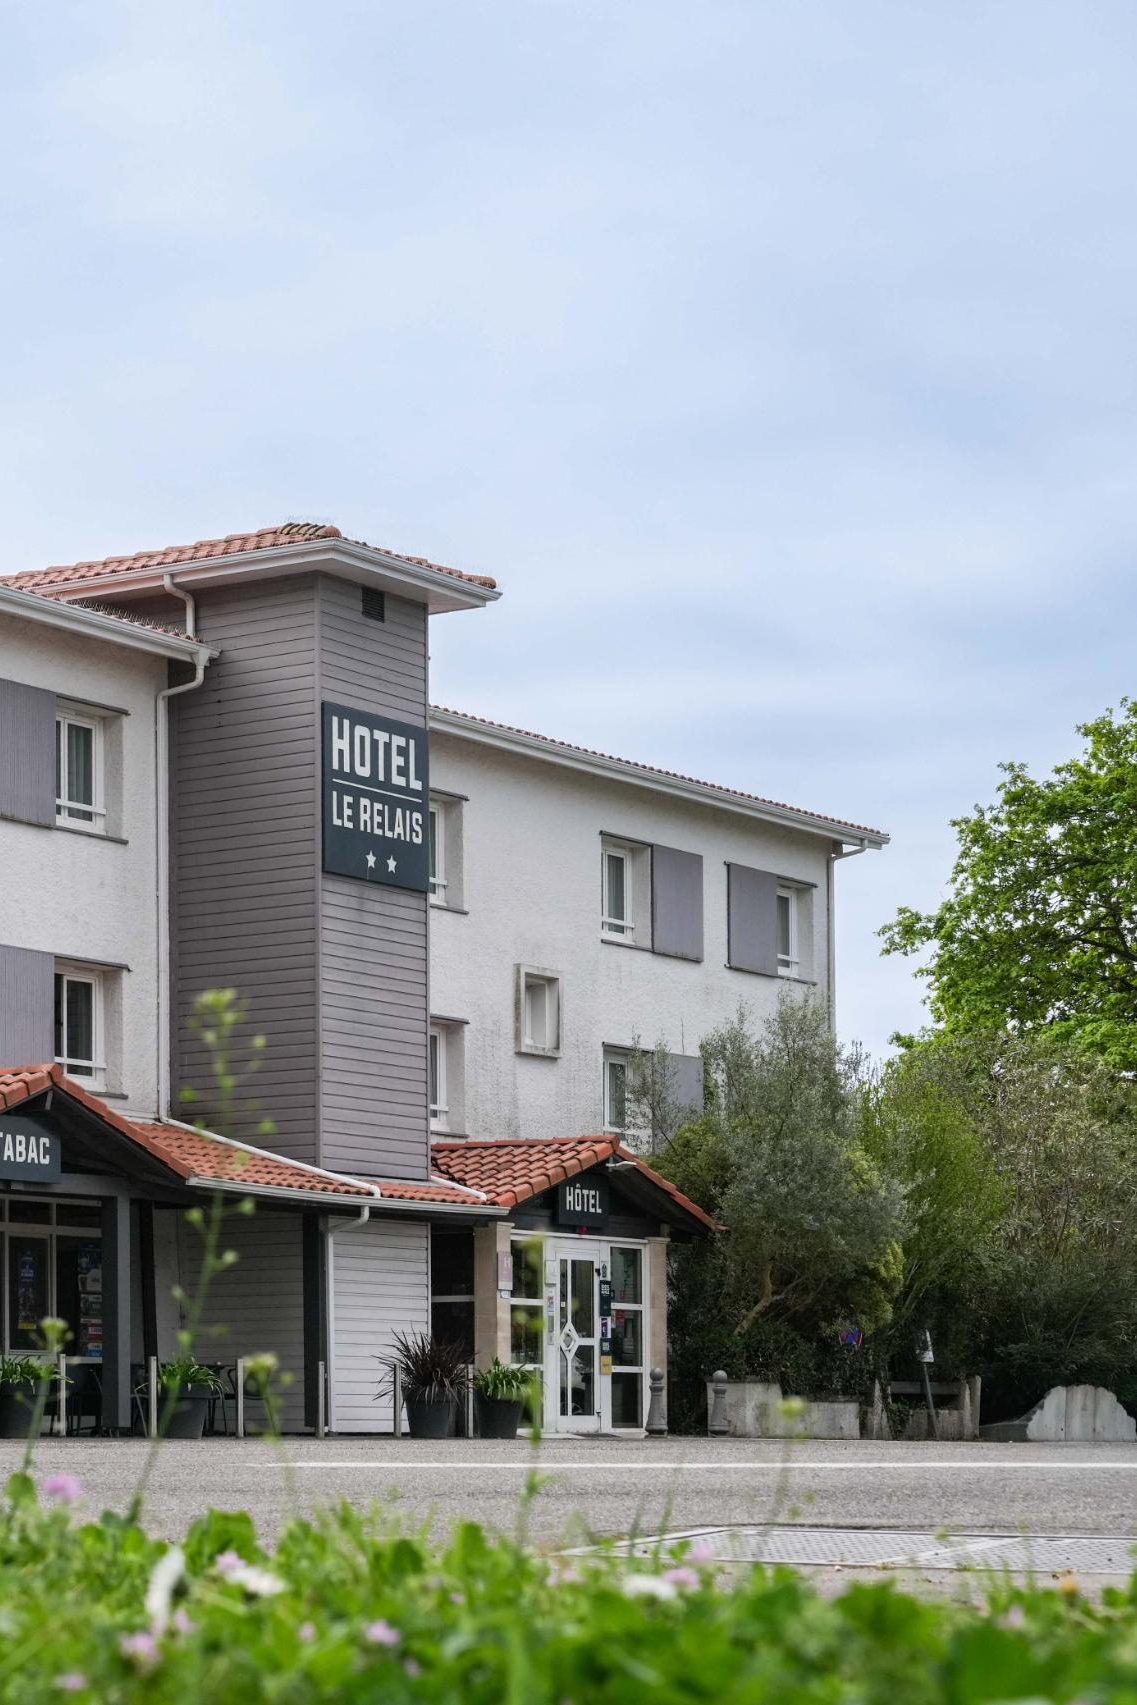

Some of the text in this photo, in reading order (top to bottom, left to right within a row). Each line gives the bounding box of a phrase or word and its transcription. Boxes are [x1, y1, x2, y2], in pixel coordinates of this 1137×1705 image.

[331, 715, 423, 791] HOTEL
[332, 790, 423, 845] LE RELAIS
[565, 1183, 603, 1214] HÔTEL
